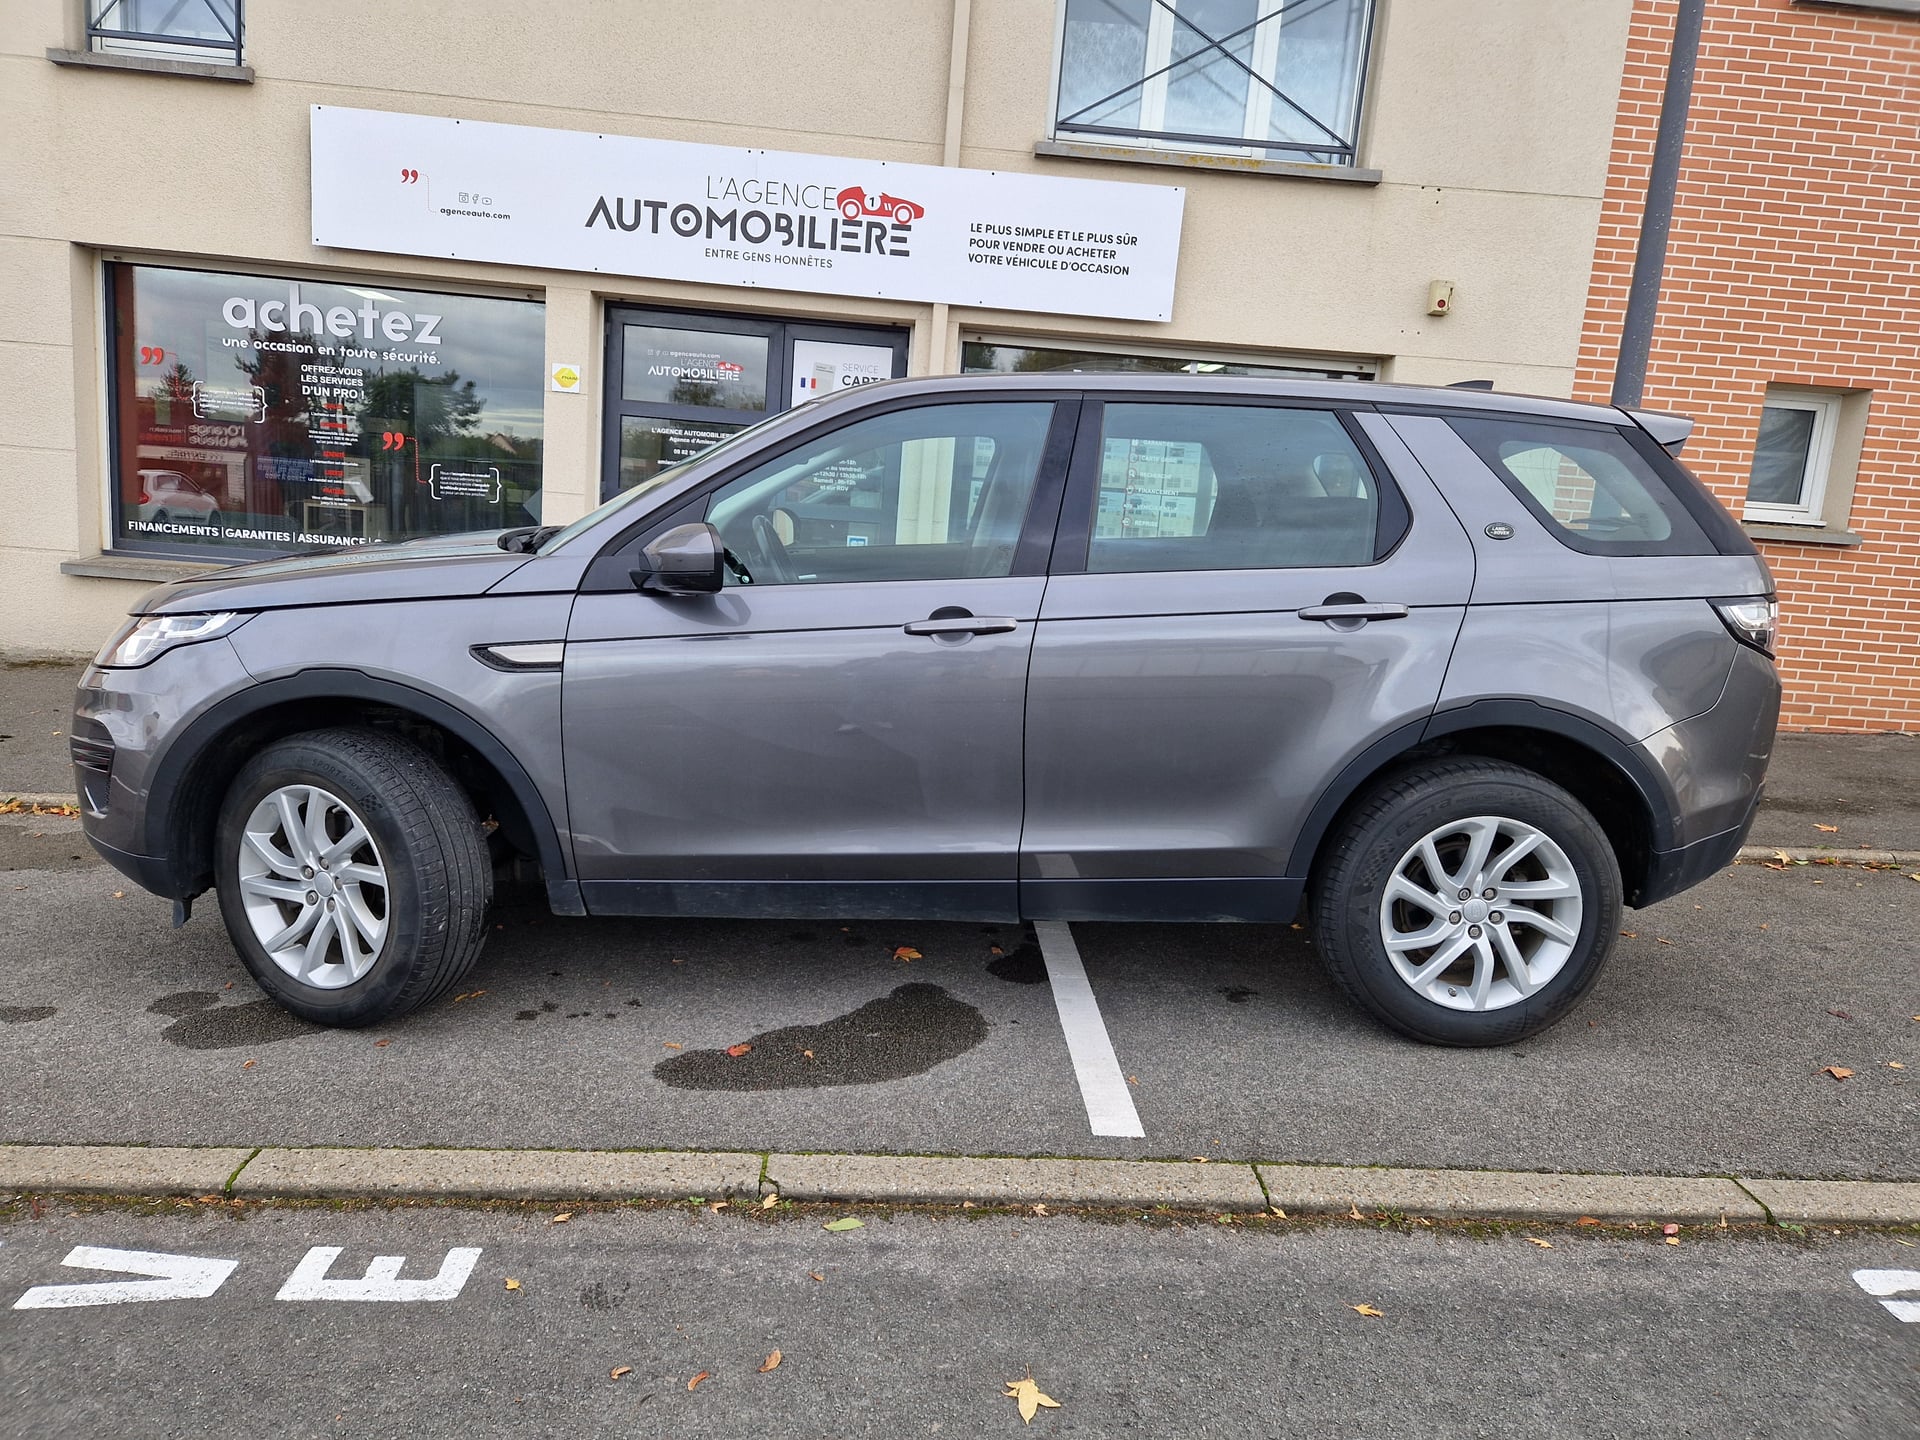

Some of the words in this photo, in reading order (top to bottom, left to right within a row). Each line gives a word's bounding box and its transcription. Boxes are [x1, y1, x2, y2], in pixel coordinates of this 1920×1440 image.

[706, 175, 837, 211] L'AGENCE
[440, 207, 511, 220] agenceauto.com
[970, 222, 983, 233] LE
[985, 224, 1012, 236] PLUS
[1014, 226, 1055, 239] SIMPLE
[1057, 230, 1070, 241] ET
[1072, 231, 1084, 242] LE
[1087, 232, 1114, 244] PLUS
[1116, 232, 1138, 246] SÛR
[969, 238, 1001, 249] POUR
[1003, 241, 1045, 254] VENDRE
[1047, 244, 1065, 255] OU
[1066, 246, 1117, 260] ACHETER
[704, 248, 739, 260] ENTRE
[742, 251, 771, 263] GENS
[774, 254, 833, 268] HONNÊTES
[968, 253, 1003, 265] VOTRE
[1005, 254, 1058, 270] VÉHICULE
[1060, 261, 1130, 276] D'OCCASION
[222, 283, 443, 345] achetez
[222, 338, 249, 349] une
[253, 339, 313, 354] occasion
[318, 346, 335, 357] en
[339, 345, 378, 360] toute
[382, 347, 441, 365] sécurité.
[300, 364, 363, 377] OFFREZ-VOUS
[680, 358, 719, 368] L'AGENCE
[842, 362, 879, 374] SERVICE
[300, 374, 319, 384] LES
[319, 376, 364, 387] SERVICES
[841, 374, 886, 387] CART
[301, 385, 330, 397] D'UN
[333, 387, 358, 399] PRO
[651, 427, 683, 435] L'AGENCE
[127, 520, 219, 537] FINANCEMENTS
[225, 527, 290, 542] GARANTIES
[297, 533, 366, 547] ASSURANCE
